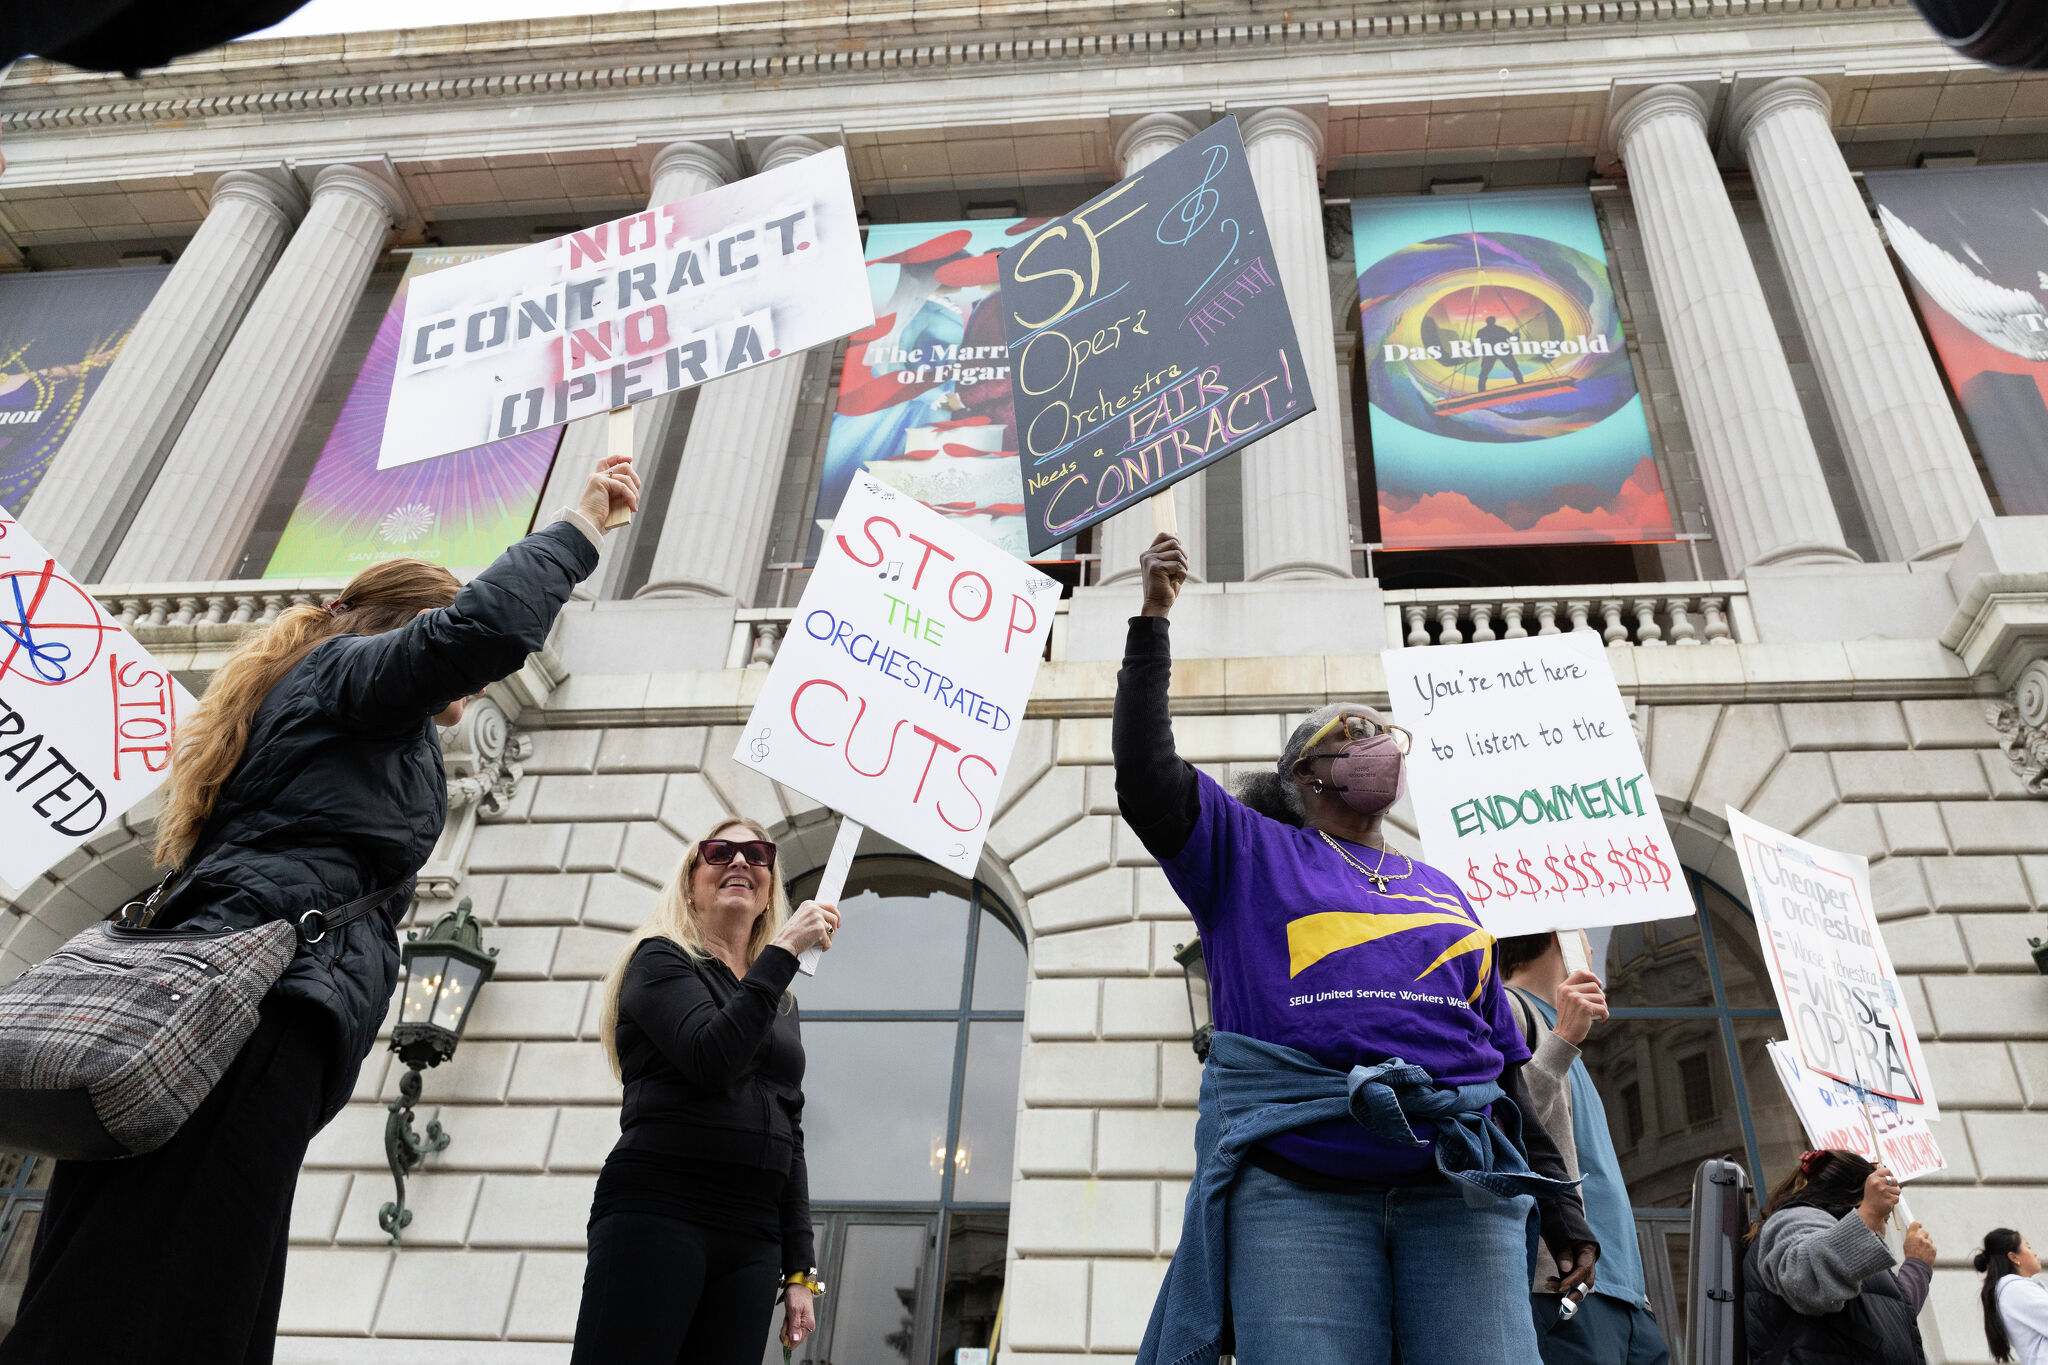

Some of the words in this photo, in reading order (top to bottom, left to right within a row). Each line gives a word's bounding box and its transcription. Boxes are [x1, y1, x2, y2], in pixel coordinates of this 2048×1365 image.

[570, 212, 656, 270] NO
[1014, 176, 1149, 329] SF
[572, 305, 671, 371] NO
[872, 344, 923, 364] The
[1020, 310, 1150, 398] Opera
[1383, 343, 1442, 362] Das
[1449, 334, 1610, 359] Rheingold
[897, 364, 931, 385] of
[1027, 364, 1182, 456] Orchestra
[1028, 461, 1077, 494] Needs
[1094, 446, 1105, 459] a
[1124, 365, 1229, 451] FAIR
[1044, 349, 1298, 533] CONTRACT!
[836, 516, 1037, 653] STOP
[883, 593, 945, 647] THE
[806, 610, 1011, 731] ORCHESTRATED
[1413, 669, 1493, 715] You're
[1497, 661, 1537, 688] not
[1541, 658, 1587, 683] here
[118, 661, 172, 772] STOP
[1431, 737, 1454, 761] to
[1466, 731, 1530, 757] listen
[1539, 723, 1563, 747] to
[1573, 717, 1614, 739] the
[790, 679, 998, 832] CUTS
[1450, 774, 1647, 838] ENDOWMENT
[1757, 842, 1849, 915] Cheaper
[1289, 995, 1314, 1007] SEIU
[1316, 989, 1353, 1003] United
[1356, 989, 1396, 999] Service
[1399, 990, 1444, 1005] Workers
[1447, 996, 1470, 1010] West
